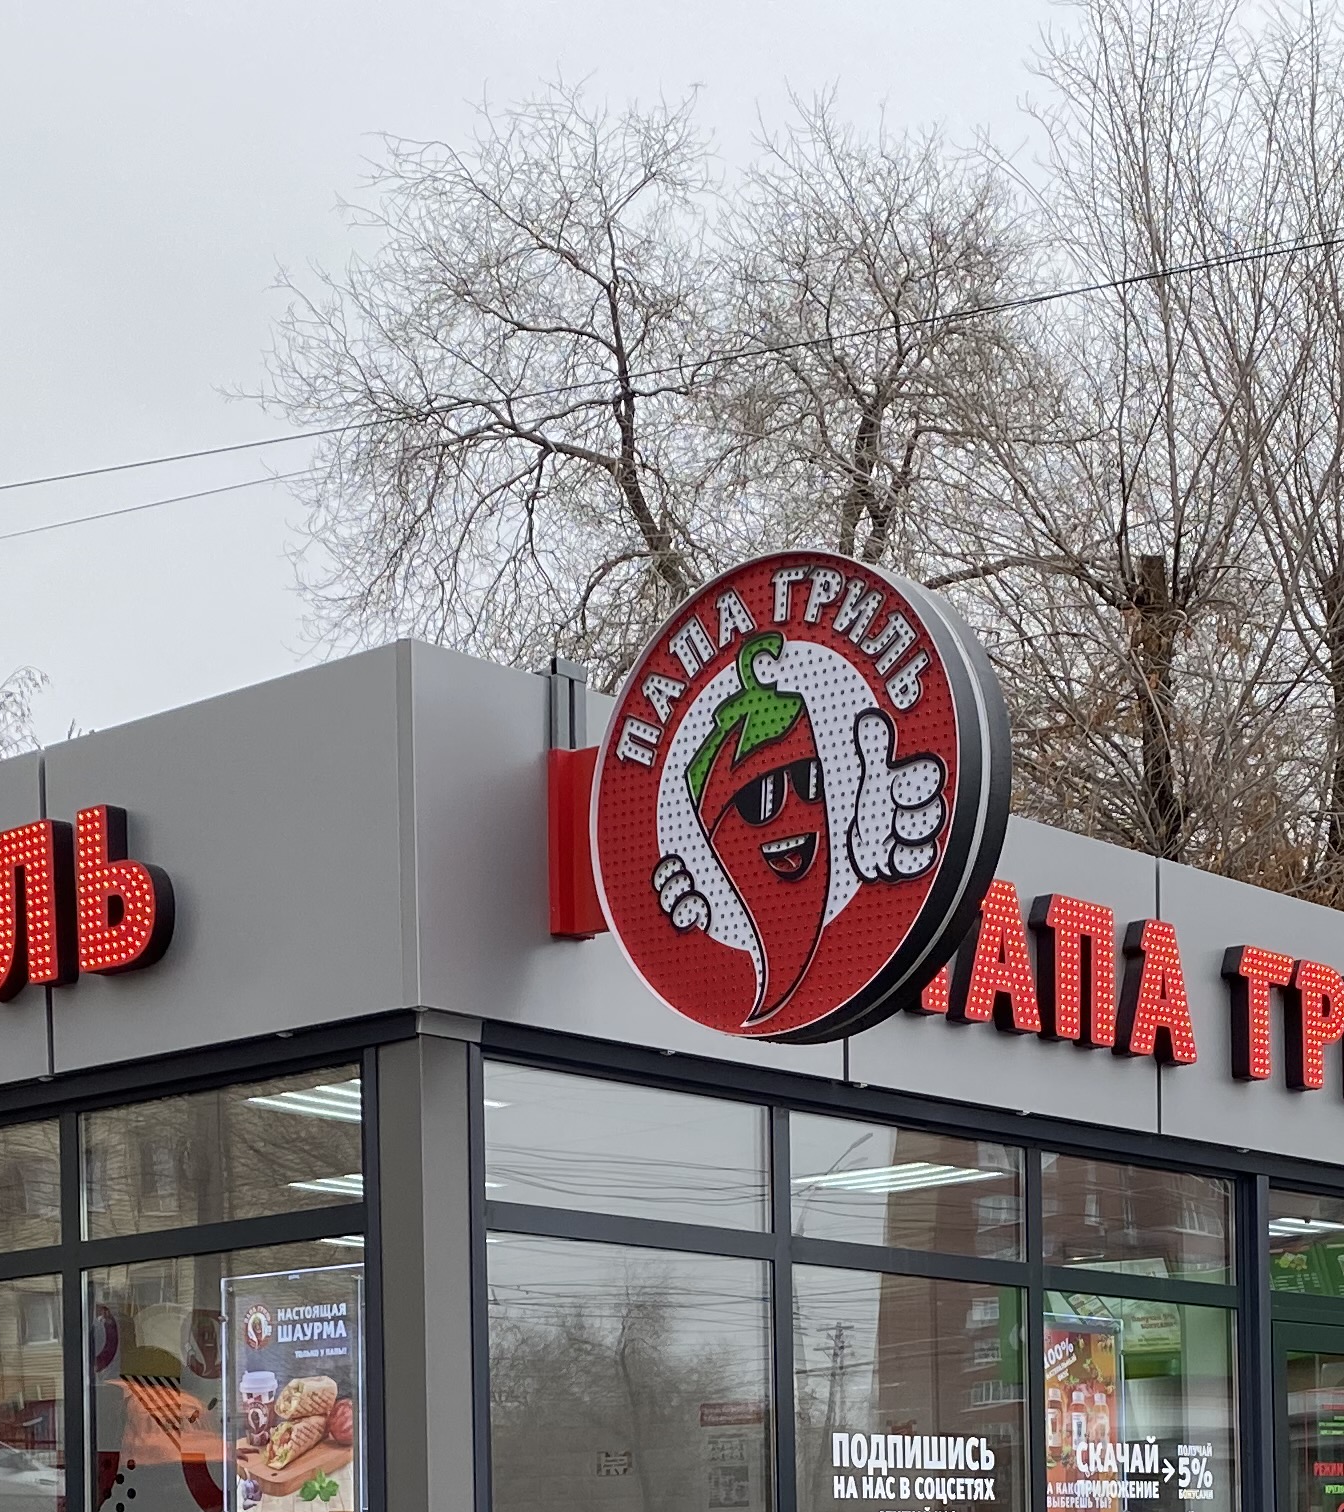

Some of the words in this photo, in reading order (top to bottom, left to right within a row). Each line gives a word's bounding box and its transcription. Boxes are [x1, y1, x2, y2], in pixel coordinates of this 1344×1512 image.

[615, 589, 758, 767] ПАПА
[769, 564, 932, 711] ГРИЛЬ
[920, 880, 1199, 1066] АПА
[277, 1302, 347, 1322] НАСТОЯЩАЯ
[277, 1319, 347, 1343] ШАУРМА
[832, 1432, 996, 1476] ПОДПИШИСЬ
[1076, 1435, 1159, 1474] СКАЧАЙ
[1178, 1457, 1213, 1489] 5%
[833, 1475, 859, 1499] НА
[862, 1476, 896, 1500] НАС
[899, 1477, 911, 1500] В
[914, 1477, 996, 1505] СОЦСЕТЯХ
[1076, 1480, 1160, 1499] ПРИЛОЖЕНИЕ
